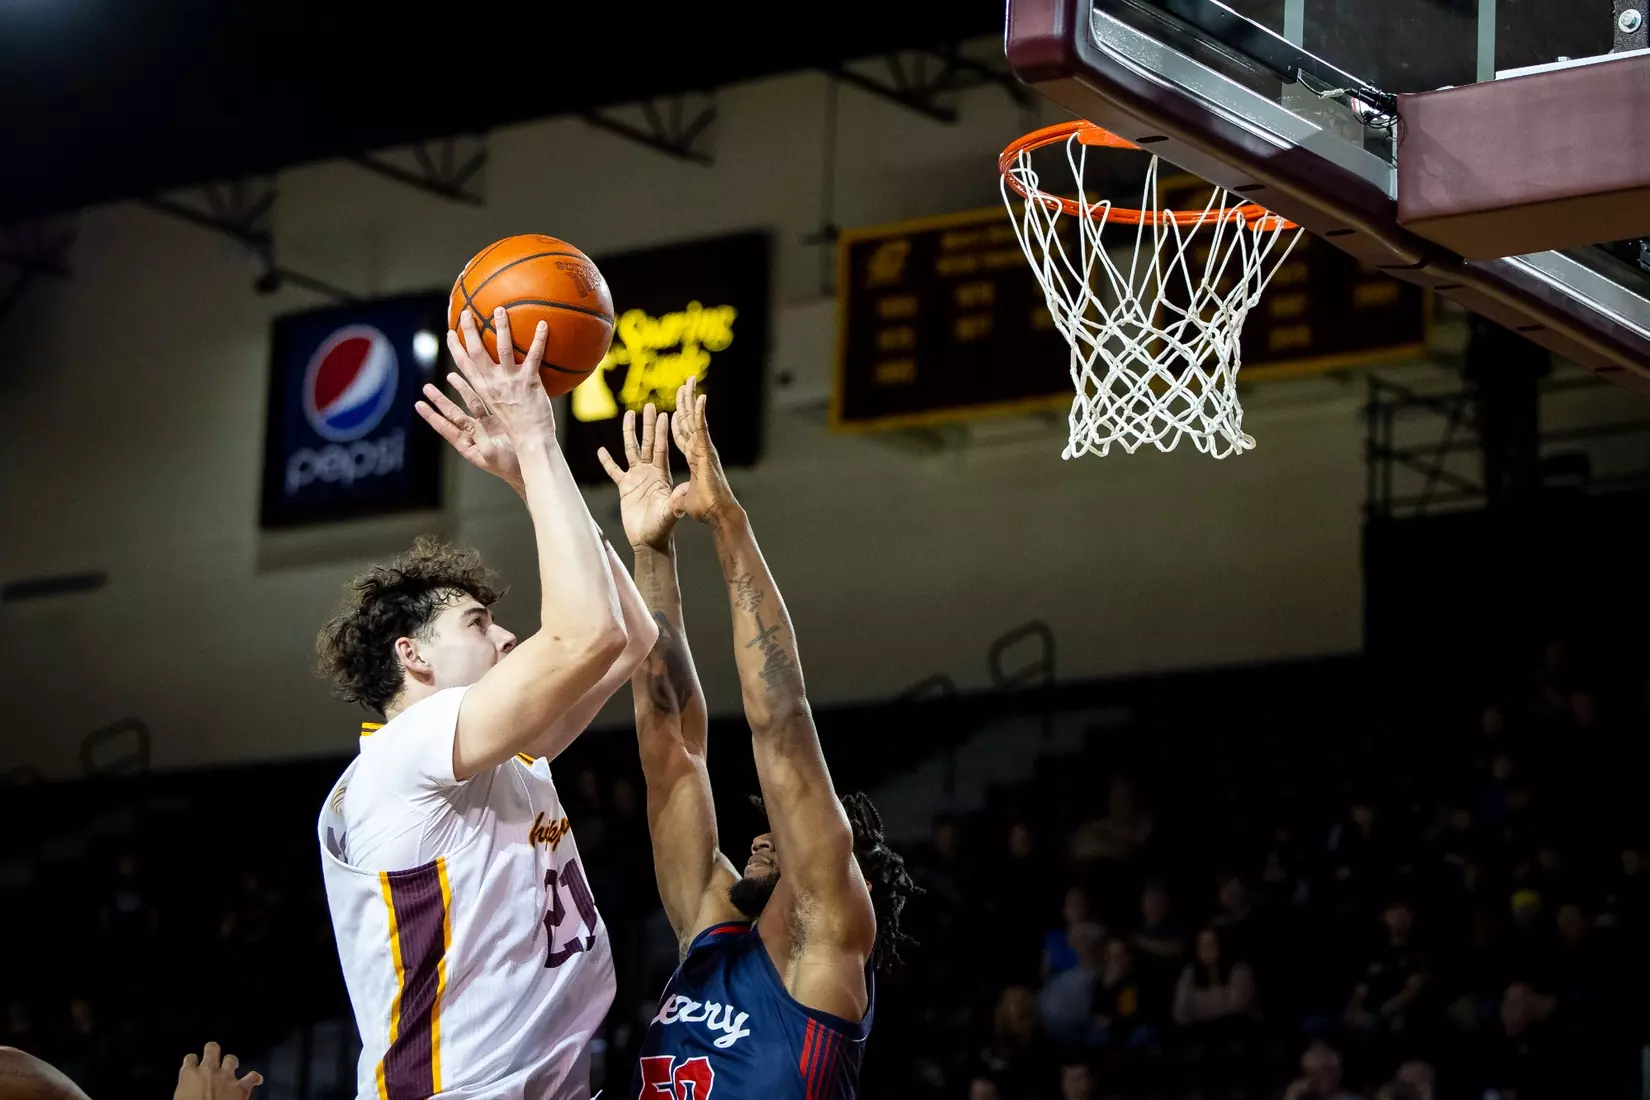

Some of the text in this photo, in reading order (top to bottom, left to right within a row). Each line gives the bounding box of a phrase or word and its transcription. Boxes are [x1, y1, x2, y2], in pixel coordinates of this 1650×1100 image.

[285, 428, 406, 495] pepsi
[543, 857, 598, 968] 21
[650, 993, 751, 1049] ercy
